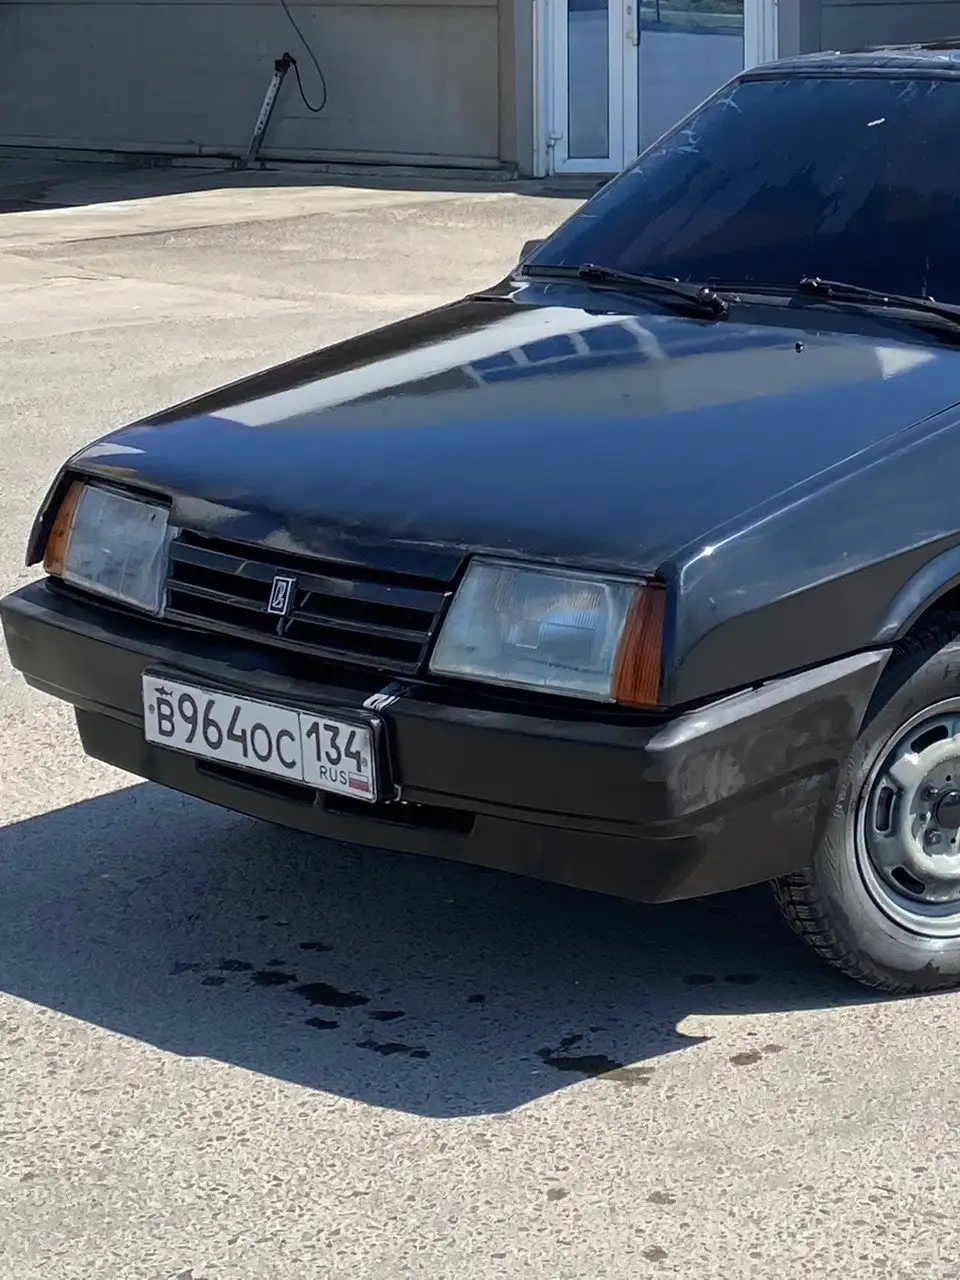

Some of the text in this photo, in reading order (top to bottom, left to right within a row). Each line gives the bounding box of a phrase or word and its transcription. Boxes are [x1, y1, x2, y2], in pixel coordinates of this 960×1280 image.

[156, 692, 362, 773] В964ОС 134
[319, 766, 348, 786] RUS
